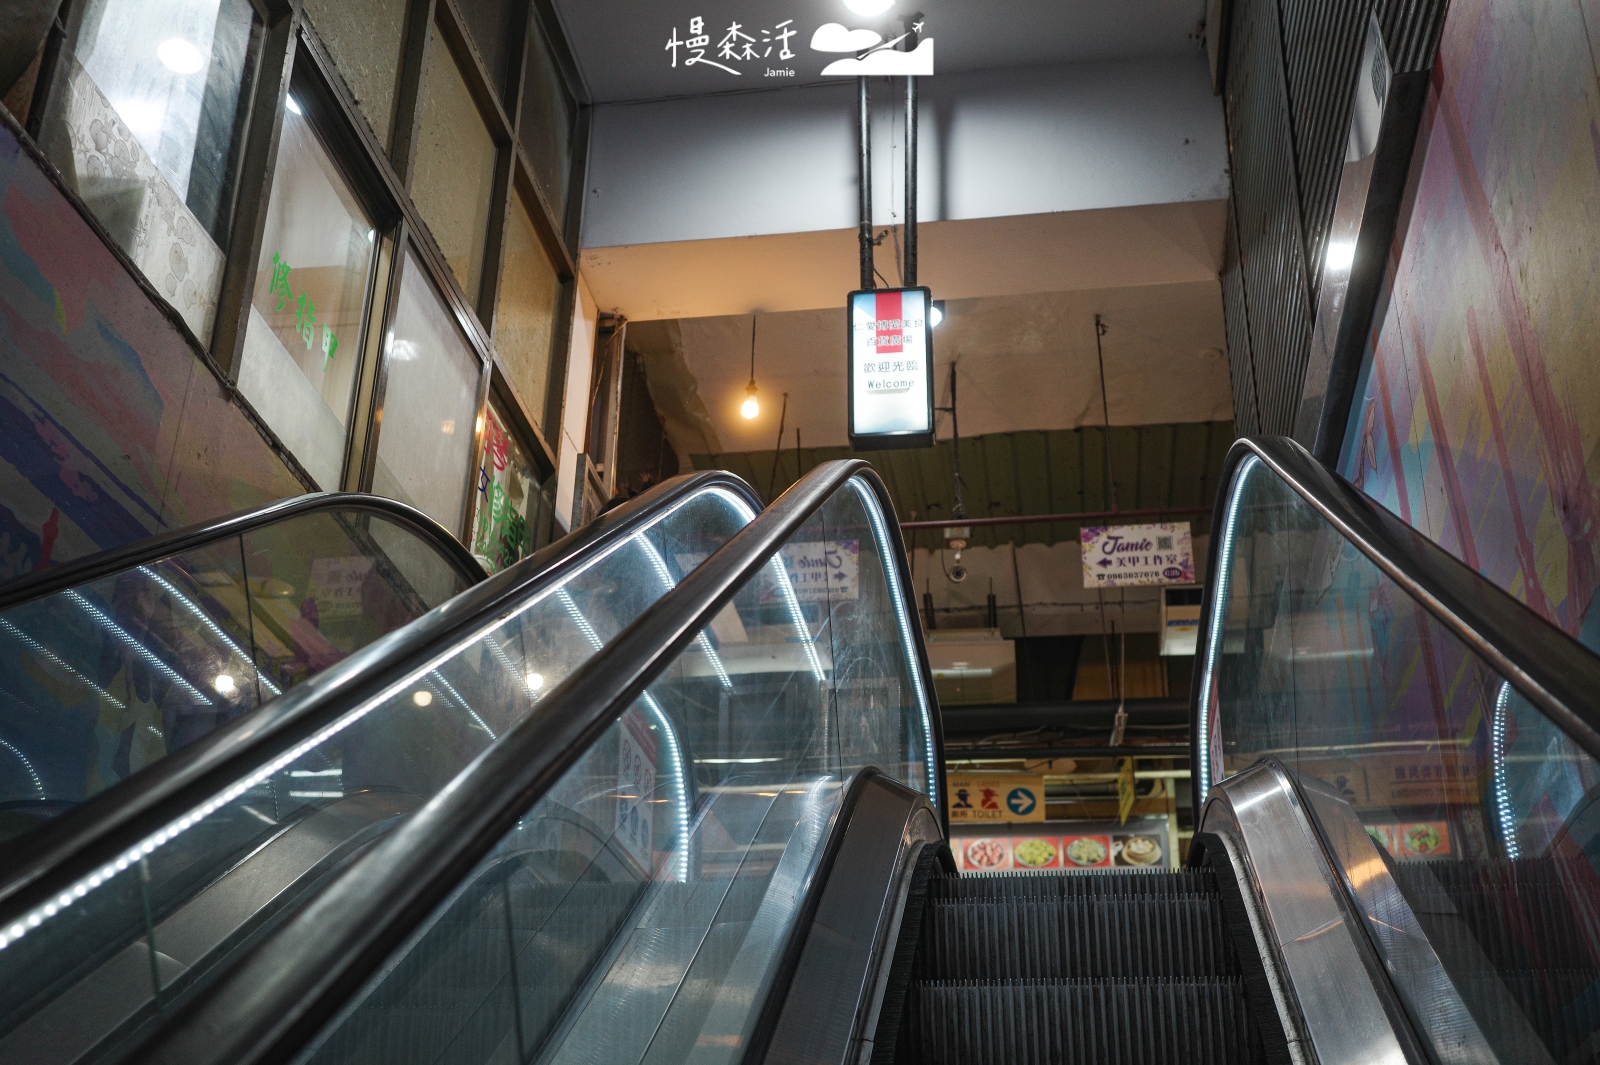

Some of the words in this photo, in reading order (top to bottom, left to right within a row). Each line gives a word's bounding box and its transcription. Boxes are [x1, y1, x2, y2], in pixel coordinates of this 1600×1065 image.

[269, 250, 338, 373] 修指甲
[854, 319, 924, 331] 仁愛博愛美食
[867, 335, 913, 346] 百貨廣場
[864, 360, 919, 373] 歡迎光臨
[867, 379, 915, 389] Welcome
[1102, 536, 1153, 555] Jamie
[1116, 554, 1177, 567] 美甲工作室
[973, 810, 1002, 818] TOILET
